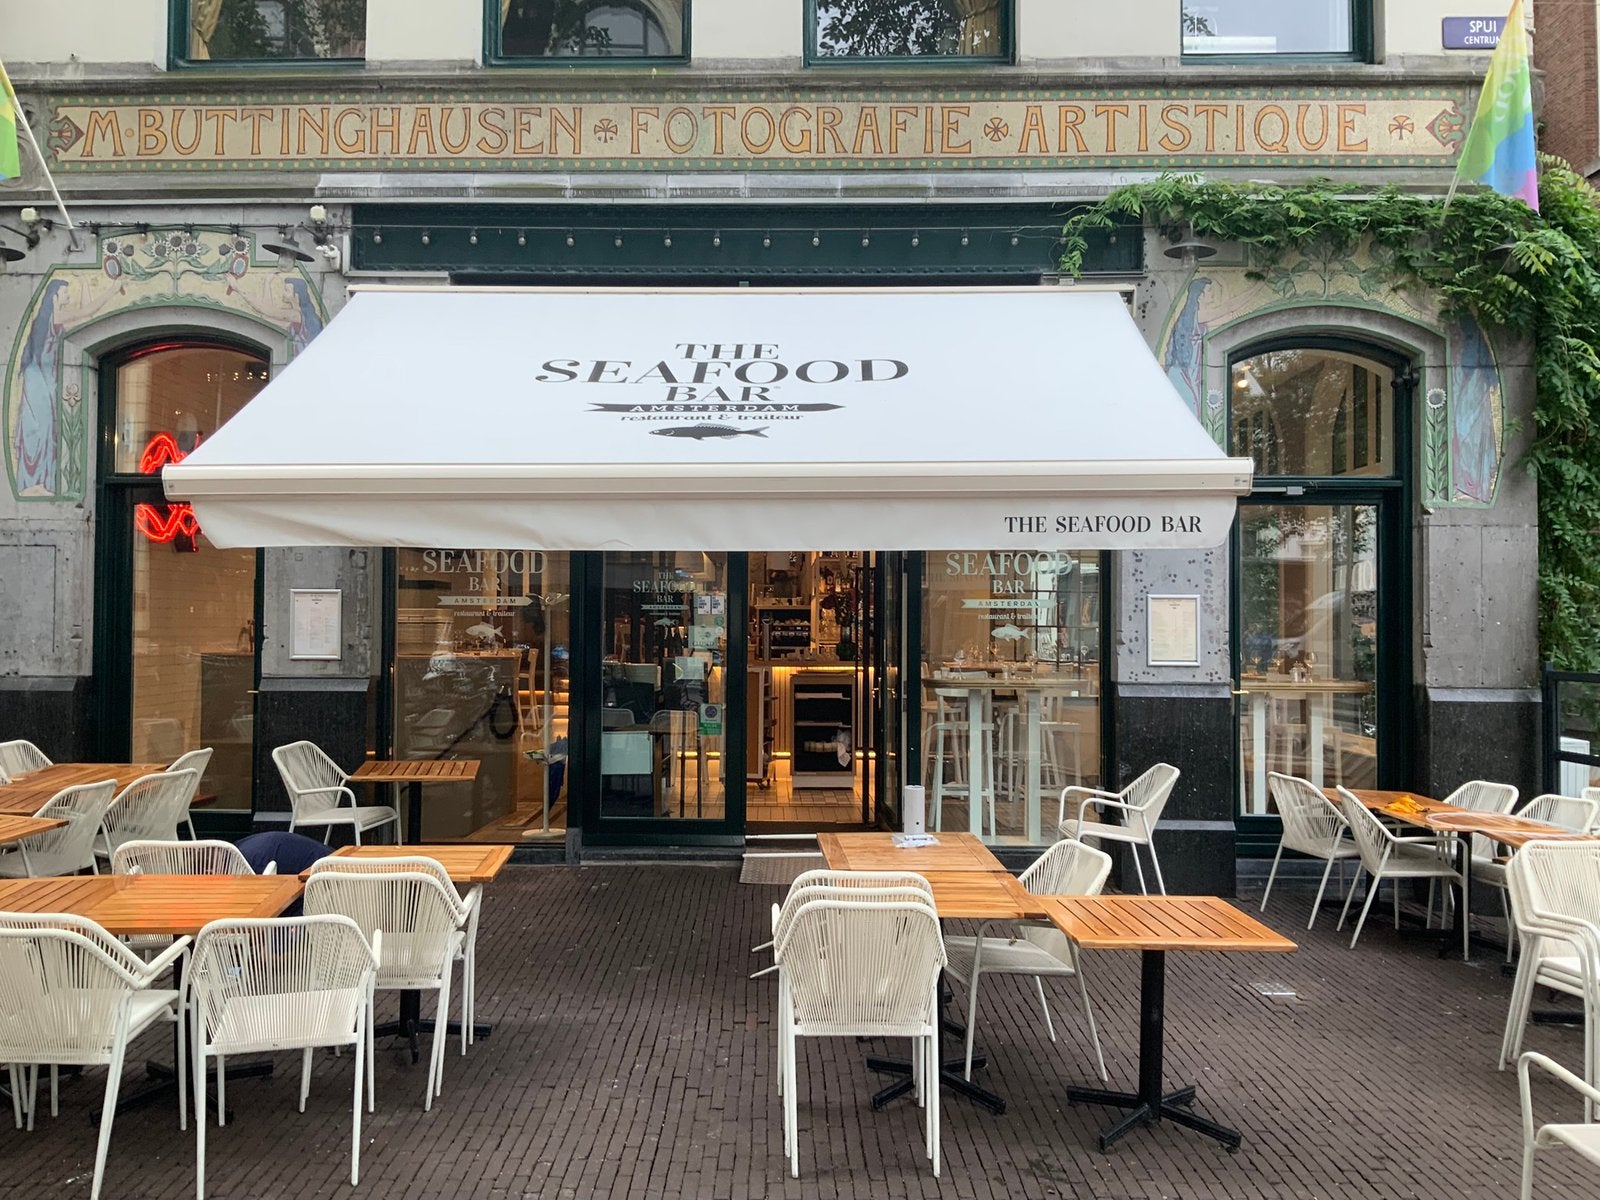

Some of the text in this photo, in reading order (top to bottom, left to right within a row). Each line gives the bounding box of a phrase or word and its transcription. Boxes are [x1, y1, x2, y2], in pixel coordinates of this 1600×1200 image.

[1469, 20, 1497, 33] SPUI
[630, 105, 972, 155] FOTOGRAFIE
[1017, 103, 1369, 154] ARTISTIQUE
[675, 343, 779, 360] THE
[535, 358, 909, 384] SEAFOOD
[662, 385, 774, 402] BAR
[629, 404, 801, 412] AMSTERDAM
[620, 413, 712, 422] restaurant
[737, 413, 804, 422] traiteur
[1004, 515, 1203, 533] THE SEAFOOD BAR
[423, 550, 548, 574] SEAFOOD
[945, 551, 1073, 576] SEAFOOD
[469, 577, 502, 591] BAR
[992, 579, 1025, 594] BAR
[657, 594, 674, 603] BAR
